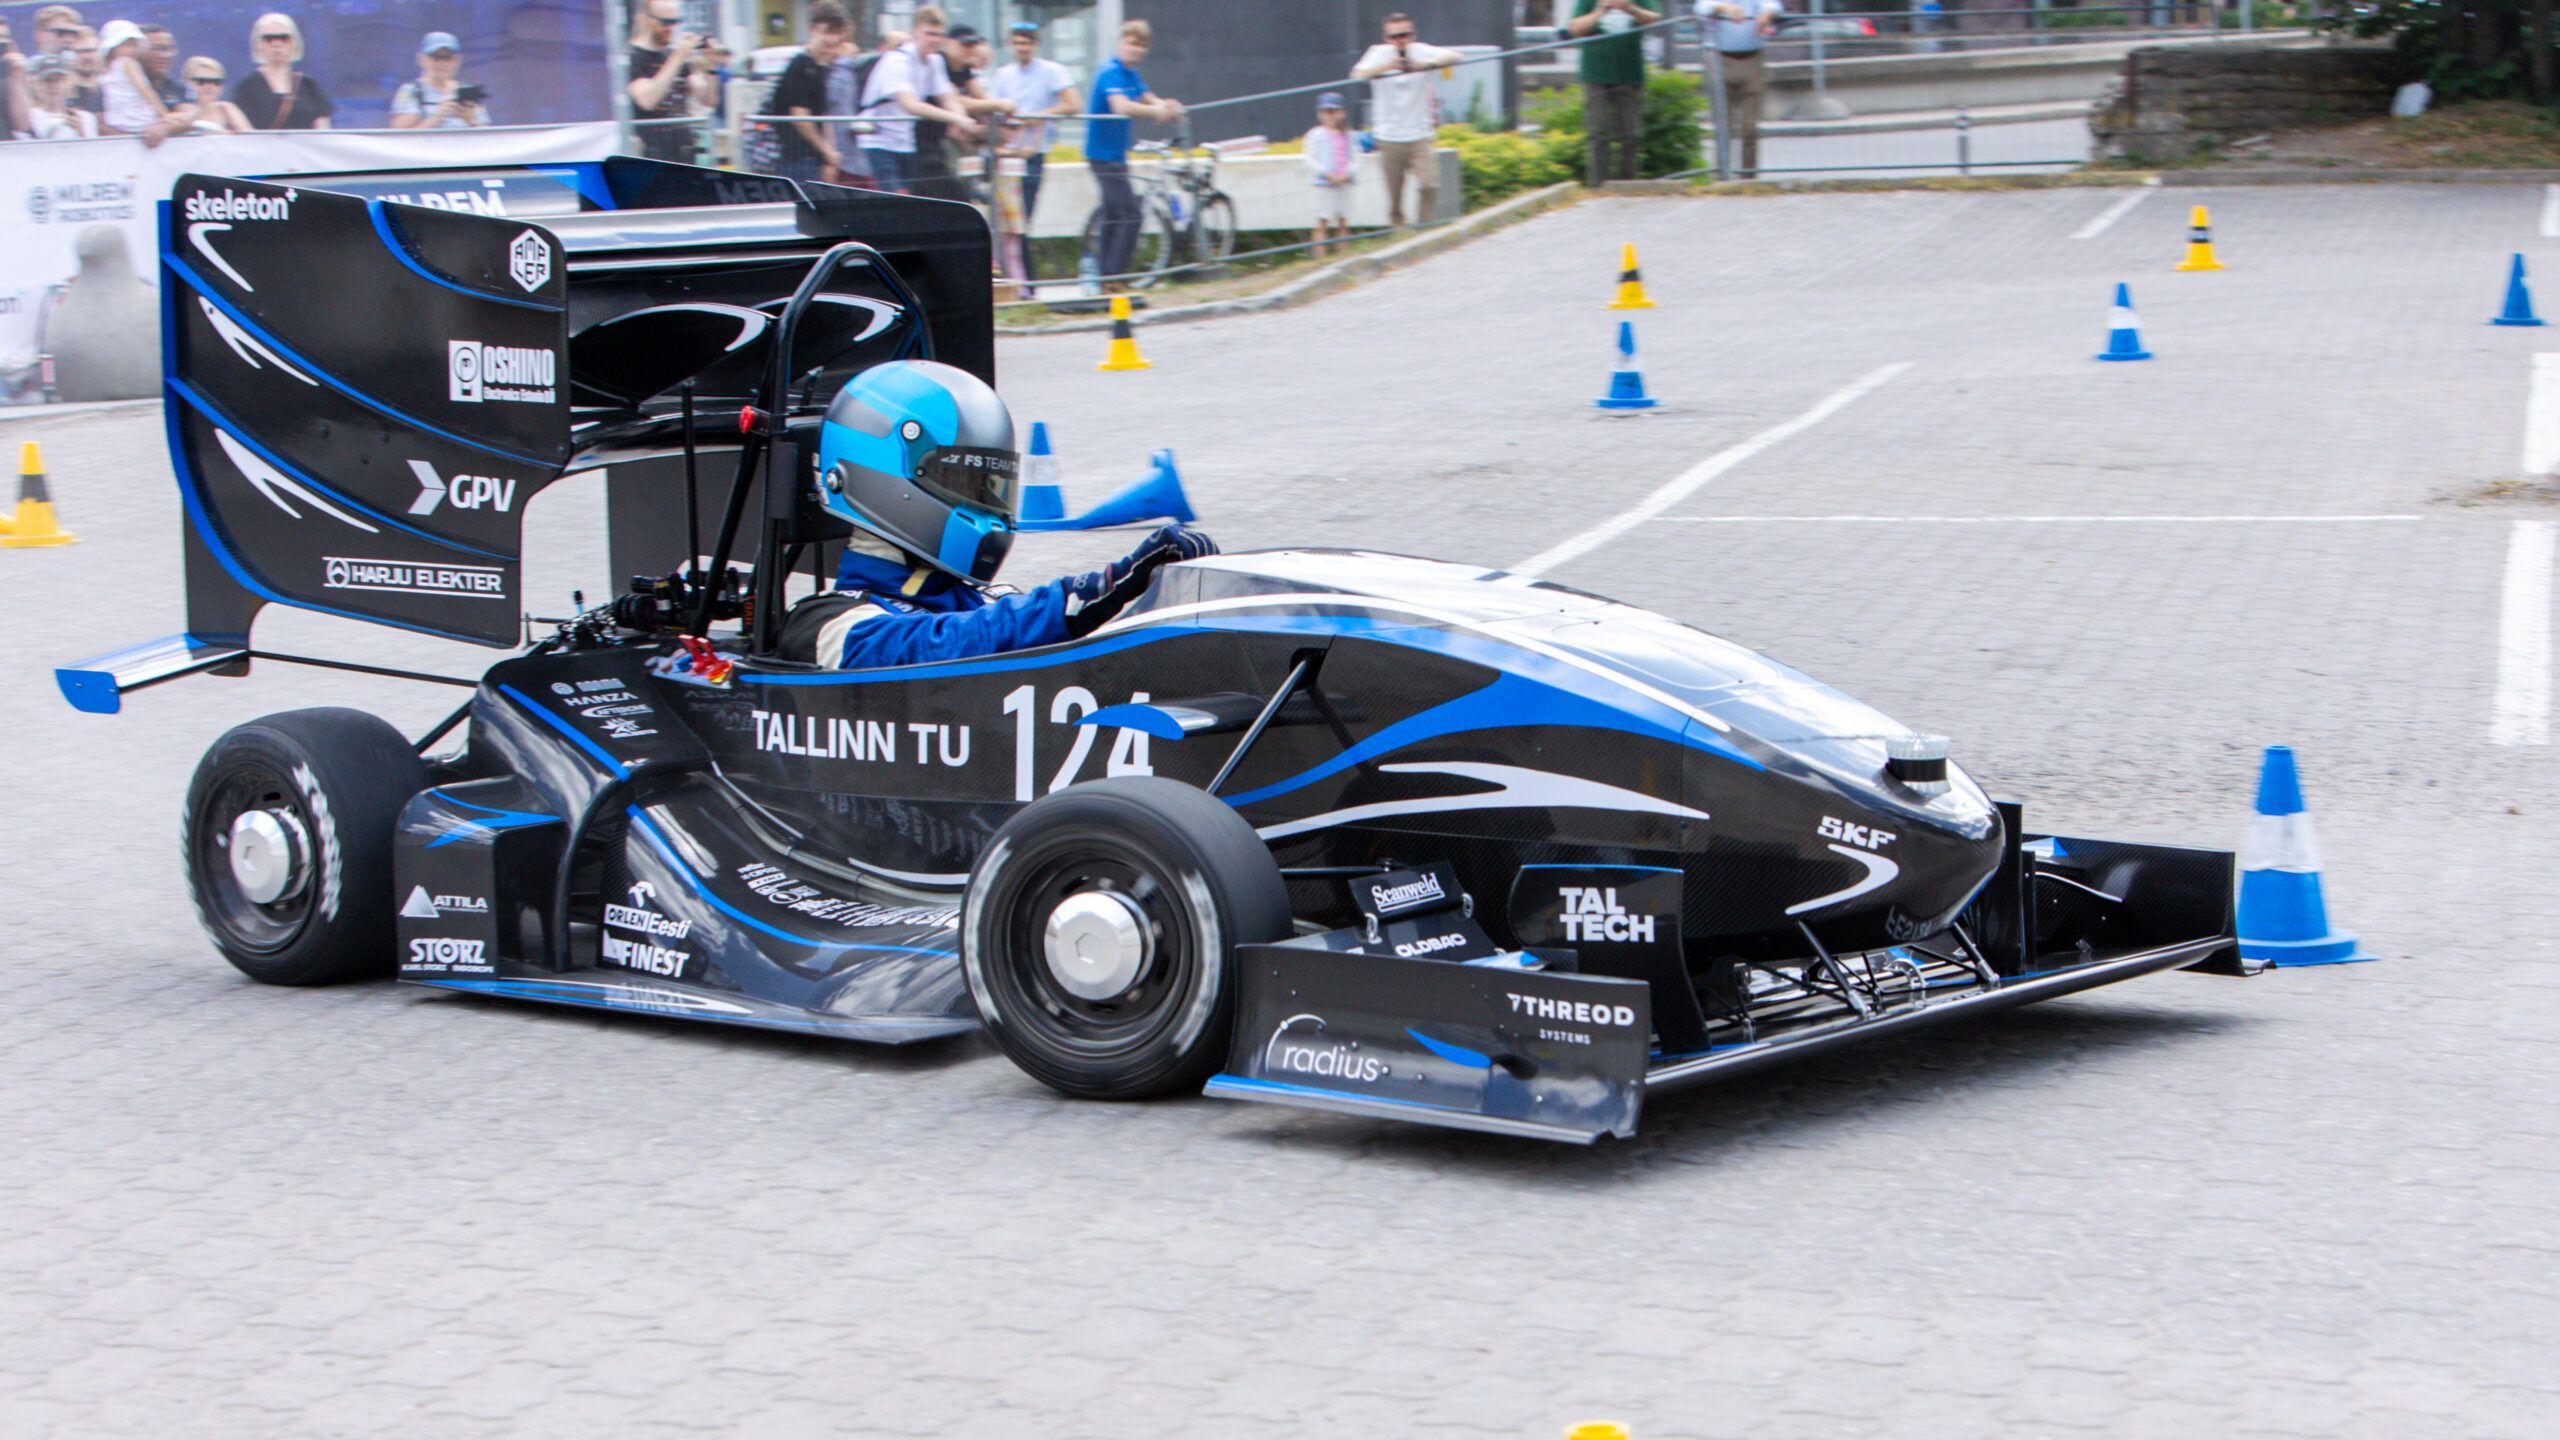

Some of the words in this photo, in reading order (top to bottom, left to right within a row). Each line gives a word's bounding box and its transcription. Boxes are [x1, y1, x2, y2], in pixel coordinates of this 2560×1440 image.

[483, 346, 556, 387] OSHINO
[964, 455, 983, 467] FS
[449, 474, 516, 512] GPV
[351, 565, 411, 585] HARJU
[415, 569, 502, 591] ELEKTER
[564, 692, 640, 707] HANZA
[751, 710, 896, 763] TALLINN
[908, 723, 971, 767] TU
[1002, 684, 1154, 802] 124
[1817, 815, 1897, 850] SKF
[433, 895, 488, 909] ATTILA
[1371, 872, 1441, 905] Scanweld
[1559, 887, 1626, 914] TAL
[608, 906, 646, 931] ORLEN
[648, 914, 692, 939] Eesti
[1559, 914, 1655, 943] TECH
[409, 938, 486, 964] STORZ
[622, 941, 691, 978] FINEST
[1539, 1029, 1592, 1045] SYSTEMS
[1282, 1044, 1380, 1083] radius
